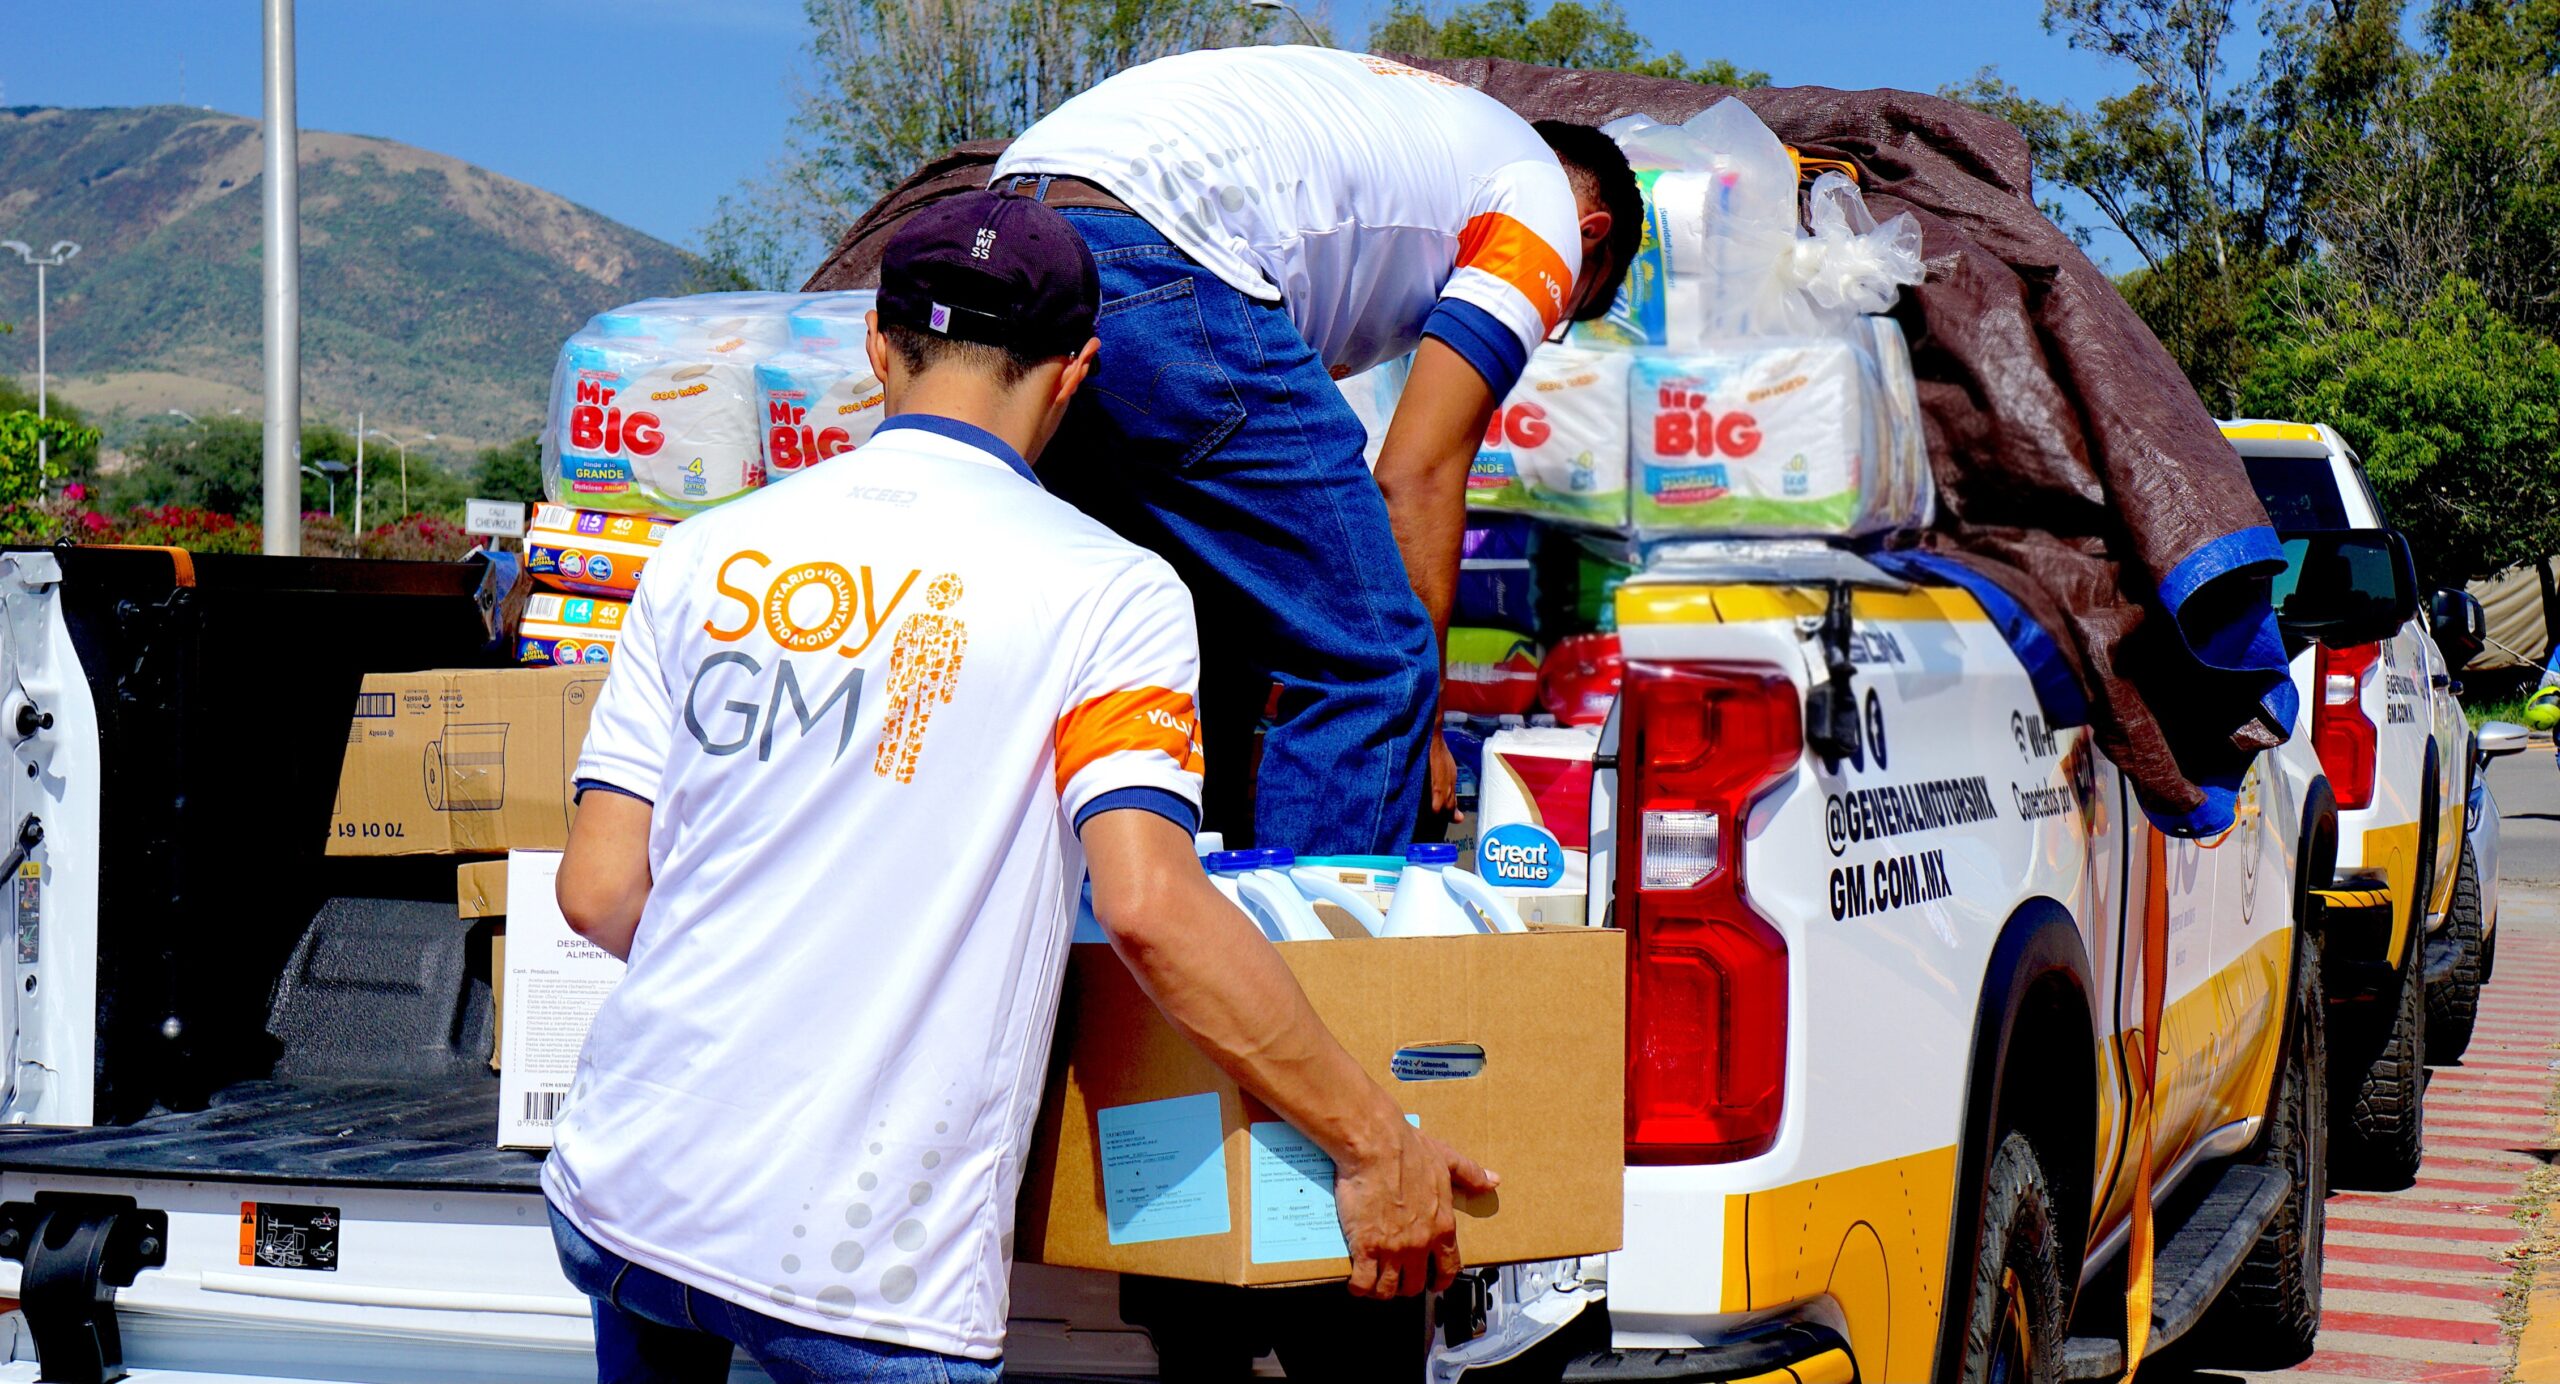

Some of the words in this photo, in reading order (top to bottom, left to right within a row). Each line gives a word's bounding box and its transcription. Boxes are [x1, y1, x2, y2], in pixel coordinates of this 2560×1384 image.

[576, 379, 616, 406] Mr
[651, 390, 678, 401] 600
[678, 383, 709, 398] hojas
[769, 400, 806, 426] Mr
[570, 404, 666, 456] BIG
[1483, 401, 1551, 449] IG
[1654, 410, 1764, 458] BIG
[769, 424, 857, 470] BIG
[575, 468, 625, 479] GRANDE
[687, 457, 704, 477] 4
[1470, 463, 1505, 474] ANDE
[488, 507, 506, 516] CALLE
[475, 518, 517, 529] CHEVROLET
[589, 514, 602, 528] 5
[613, 518, 633, 530] 40
[575, 601, 588, 617] 4
[600, 606, 619, 619] 40
[684, 651, 865, 768] GM
[1826, 775, 1998, 857] @GENERALMOTORSMX
[362, 823, 380, 838] 01
[385, 823, 405, 838] 70
[1484, 837, 1549, 865] Great
[1496, 861, 1550, 880] Value
[1829, 848, 1953, 921] GM.COM.MX
[557, 939, 597, 948] DESPEN
[1420, 1061, 1449, 1069] Salmonella
